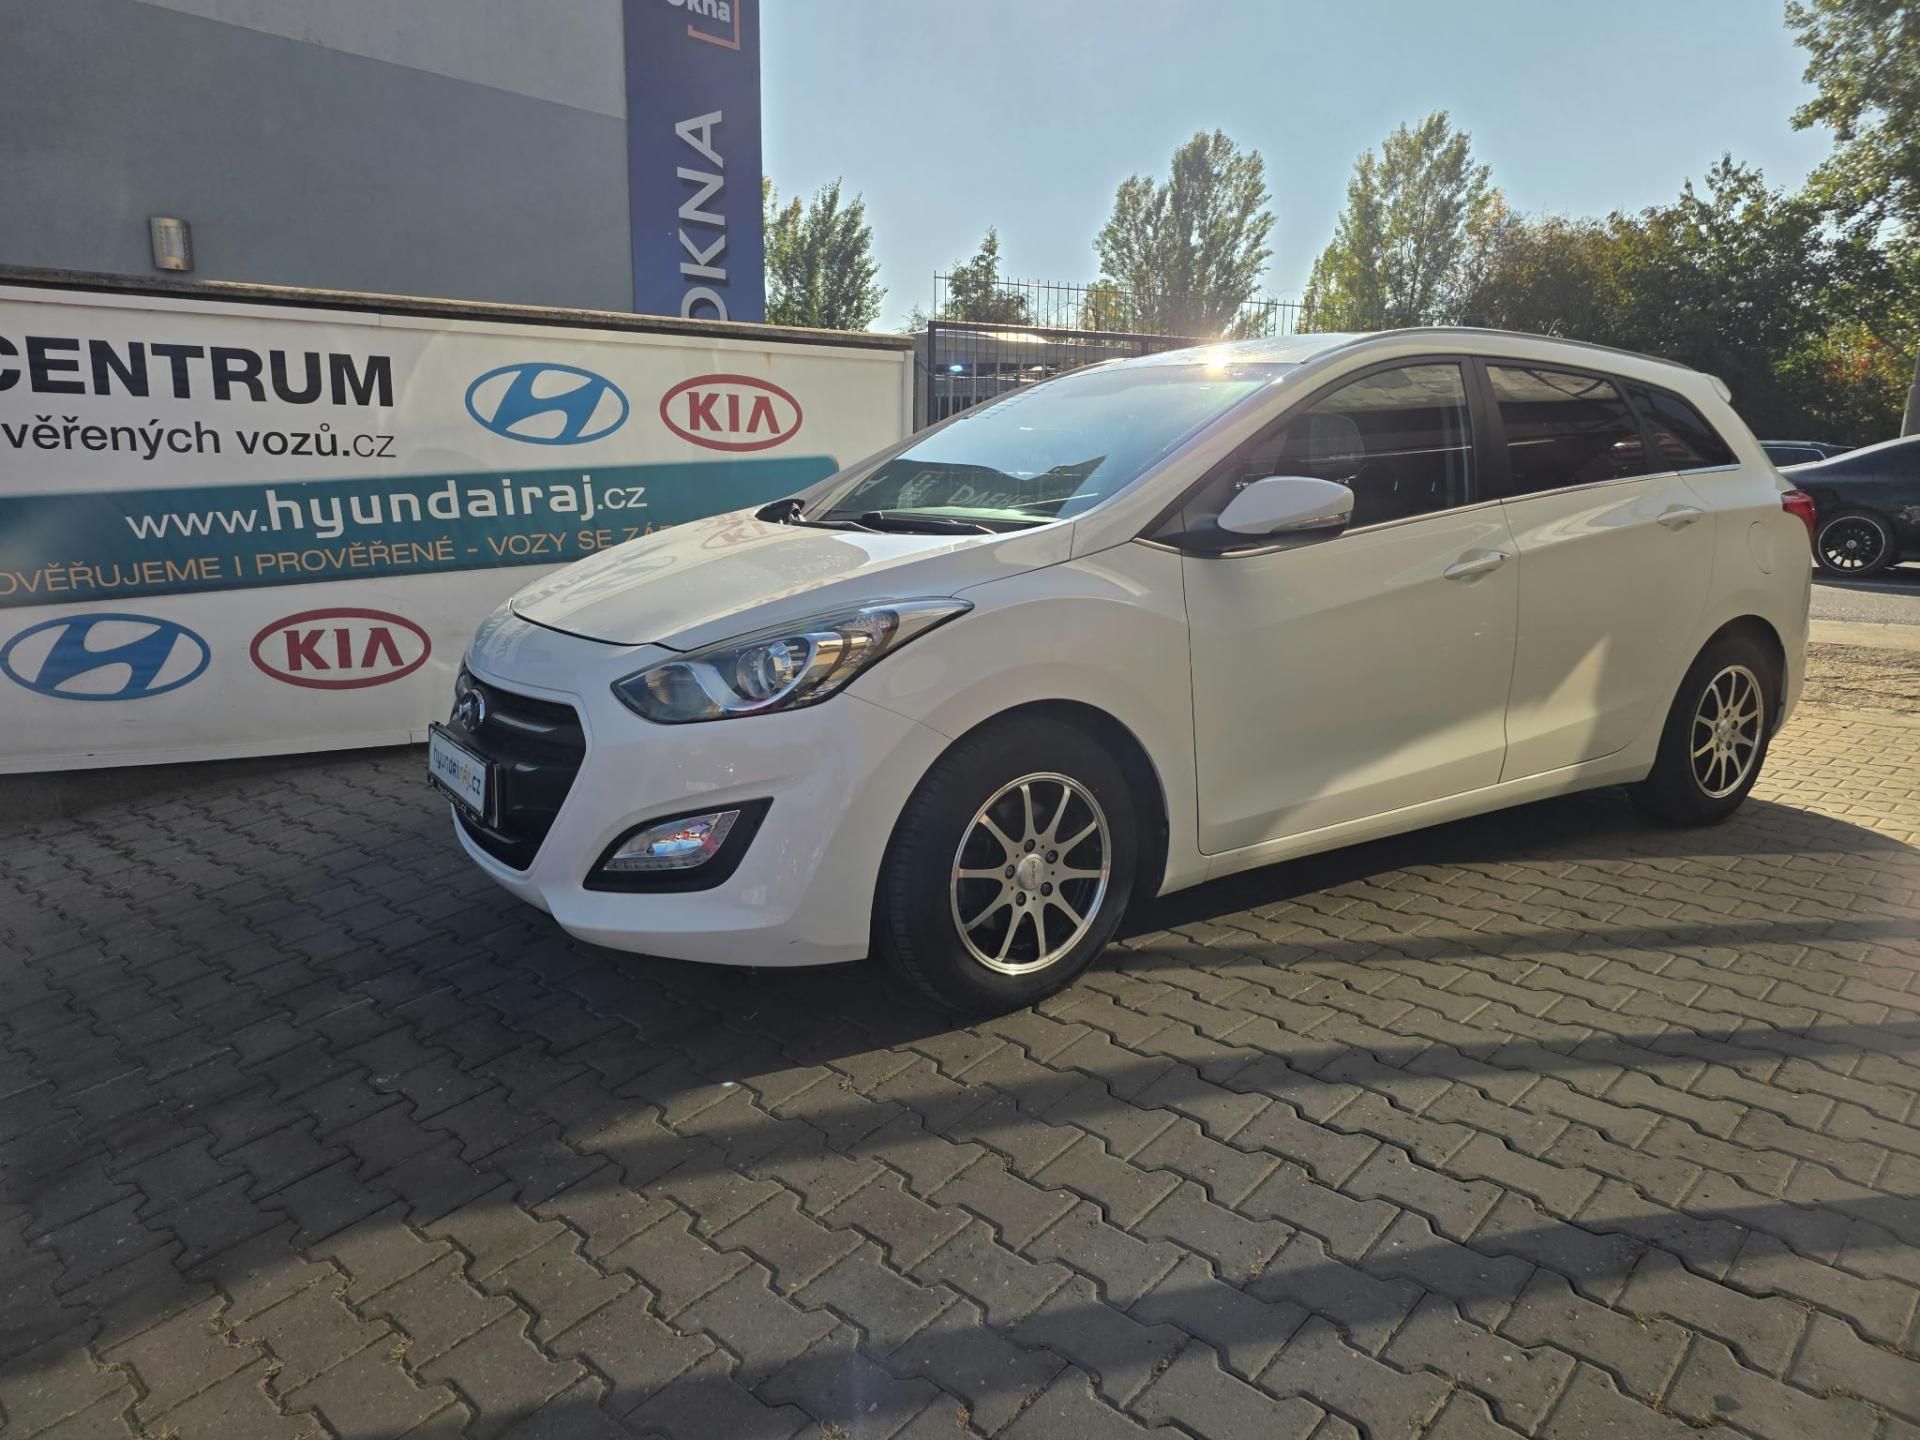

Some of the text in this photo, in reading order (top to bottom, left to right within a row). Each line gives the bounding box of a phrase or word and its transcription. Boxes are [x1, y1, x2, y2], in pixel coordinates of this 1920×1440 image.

[675, 110, 729, 321] OKNA
[686, 391, 781, 435] KIA
[235, 422, 397, 458] vozů.cz
[125, 474, 648, 540] www.hyundairaj.cz
[256, 537, 456, 575] PROVĚŘENÉ
[492, 531, 578, 556] VOZY
[578, 528, 613, 551] SE
[284, 627, 405, 671] KIA
